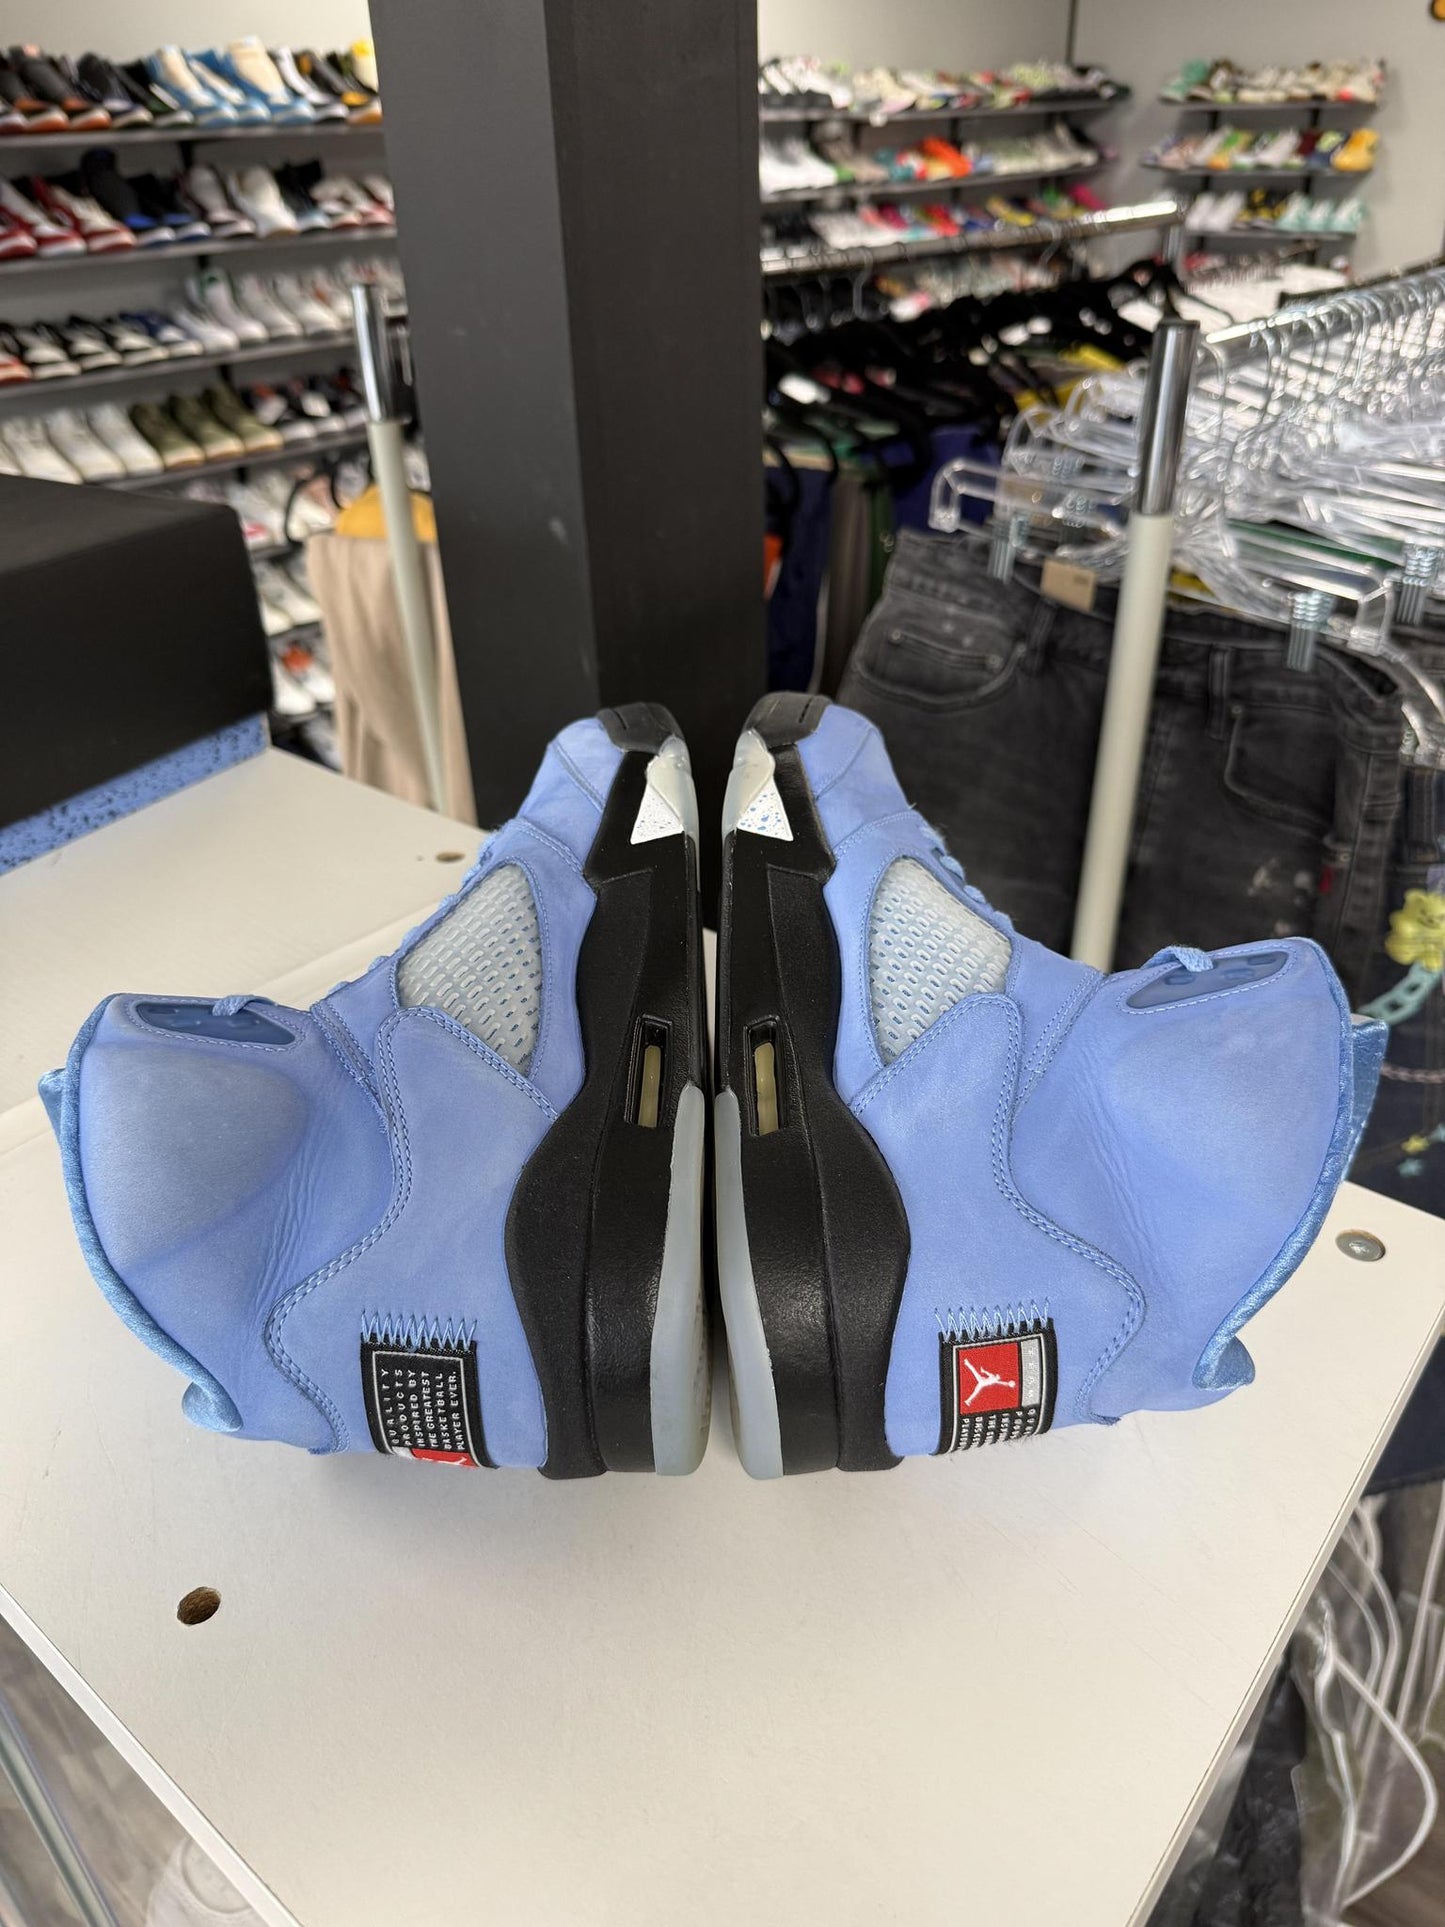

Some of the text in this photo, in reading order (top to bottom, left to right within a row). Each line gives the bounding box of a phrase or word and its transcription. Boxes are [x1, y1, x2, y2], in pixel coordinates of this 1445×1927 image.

[381, 1369, 400, 1444] QUALITY
[394, 1369, 413, 1446] PRODUCTS
[408, 1369, 426, 1447] INSPIRED BY
[421, 1371, 439, 1447] THE GREATEST
[435, 1373, 453, 1450] BASKETBALL
[448, 1371, 466, 1450] PLAYER EVER.
[1025, 1347, 1036, 1399] TEAM
